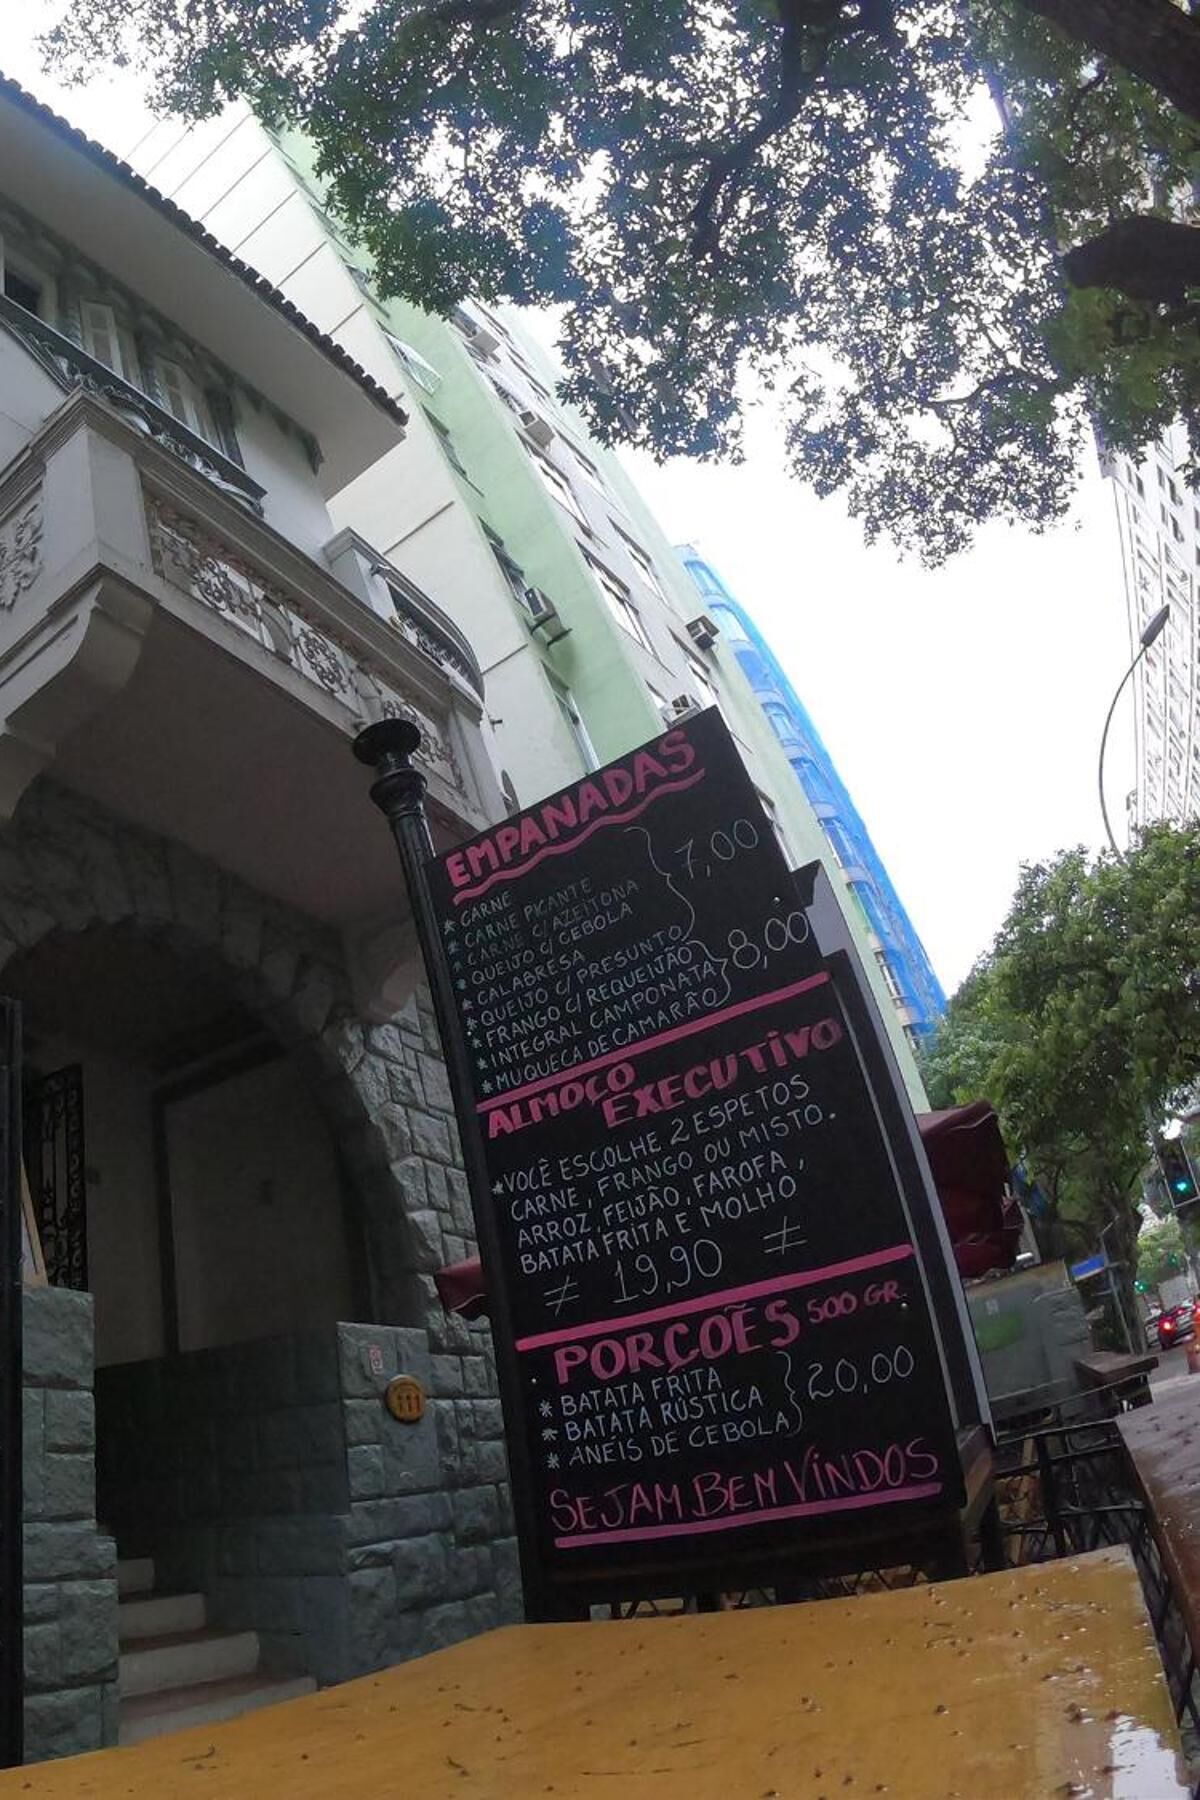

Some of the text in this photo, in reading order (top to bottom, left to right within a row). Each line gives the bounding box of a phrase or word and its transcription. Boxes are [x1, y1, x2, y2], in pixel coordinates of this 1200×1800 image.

[446, 729, 696, 887] EMPANADAS
[675, 820, 759, 879] 7,00
[460, 891, 513, 927] CARNE
[465, 877, 594, 948] CARNE PICANTE
[468, 934, 525, 966] CARNE
[552, 880, 640, 931] AZEITONA
[472, 950, 536, 984] QUEIJO
[559, 901, 633, 945] CEBOLA
[728, 911, 809, 969] 8,00
[478, 949, 586, 1006] CALABRESA
[480, 988, 549, 1027] QUEIJO
[577, 925, 682, 984] PRESUNTO
[486, 1006, 561, 1049] FRANGO
[586, 945, 693, 1007] REQUEIJÃO
[490, 960, 718, 1068] INTEGRAL CAMPONATA
[496, 987, 718, 1089] MUQUECA DE CAMARÃO
[488, 1061, 637, 1139] ALMOÇO
[503, 1074, 810, 1193] VOCÊ ESCOLHE 2 ESPETOS
[597, 1151, 693, 1198] FRANGO
[704, 1137, 731, 1164] OU
[520, 1239, 600, 1275] BATATA
[674, 1212, 692, 1235] E
[700, 1175, 797, 1228] MOLHO
[613, 1239, 723, 1304] 19,90
[554, 1299, 801, 1385] PORÇÕES
[807, 1289, 858, 1324] 500
[808, 1344, 915, 1400] 20,00
[560, 1381, 645, 1417] BATATA
[564, 1384, 765, 1442] BATATA RÚSTICA
[568, 1411, 791, 1467] ANÉIS DE CEBOLA
[549, 1483, 683, 1533] SEJAM
